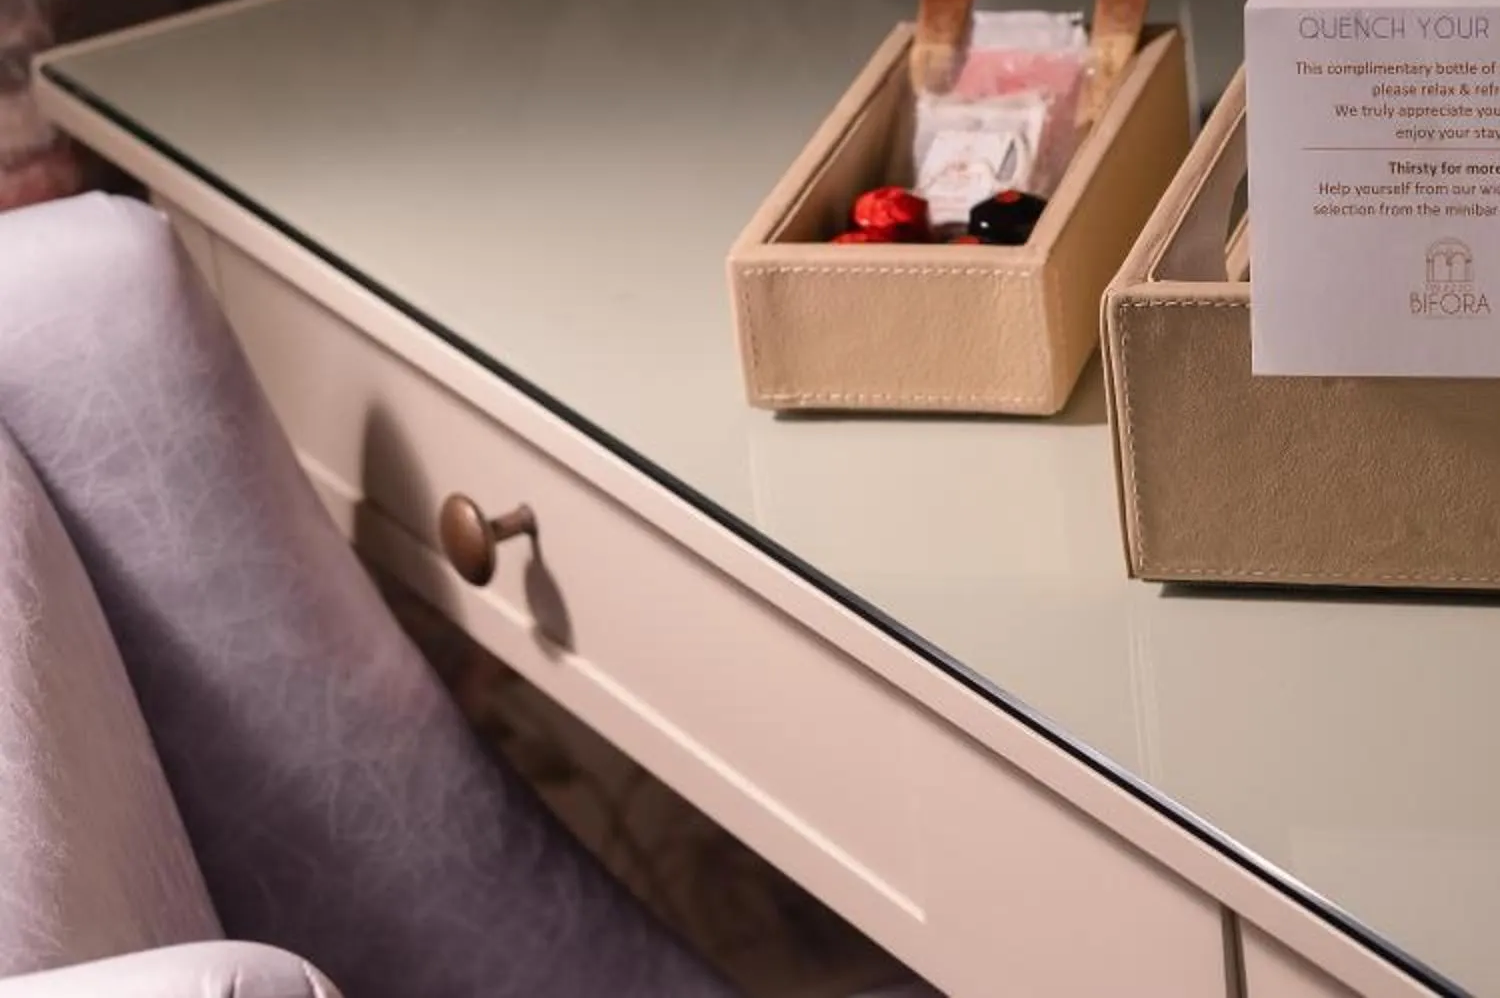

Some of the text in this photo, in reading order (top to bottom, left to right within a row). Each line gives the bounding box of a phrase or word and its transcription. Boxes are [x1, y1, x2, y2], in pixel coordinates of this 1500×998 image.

[1299, 16, 1405, 40] QUENCH
[1418, 16, 1489, 39] YOUR
[1296, 62, 1322, 75] This
[1327, 62, 1432, 78] complimentary
[1436, 62, 1478, 75] bottle
[1481, 62, 1496, 74] of
[1372, 84, 1417, 98] please
[1422, 84, 1455, 96] relax
[1460, 84, 1470, 96] &
[1335, 106, 1358, 117] We
[1362, 105, 1394, 120] truly
[1400, 106, 1472, 120] appreciate
[1396, 127, 1435, 142] enjoy
[1438, 129, 1469, 141] your
[1388, 162, 1437, 178] Thirsty
[1442, 162, 1462, 174] for
[1319, 183, 1350, 197] Help
[1354, 183, 1412, 198] yourself
[1415, 183, 1449, 196] from
[1452, 185, 1476, 195] our
[1313, 204, 1376, 216] selection
[1379, 204, 1412, 216] from
[1417, 204, 1441, 216] the
[1446, 204, 1498, 216] minibar
[1410, 292, 1491, 314] BIFORA
